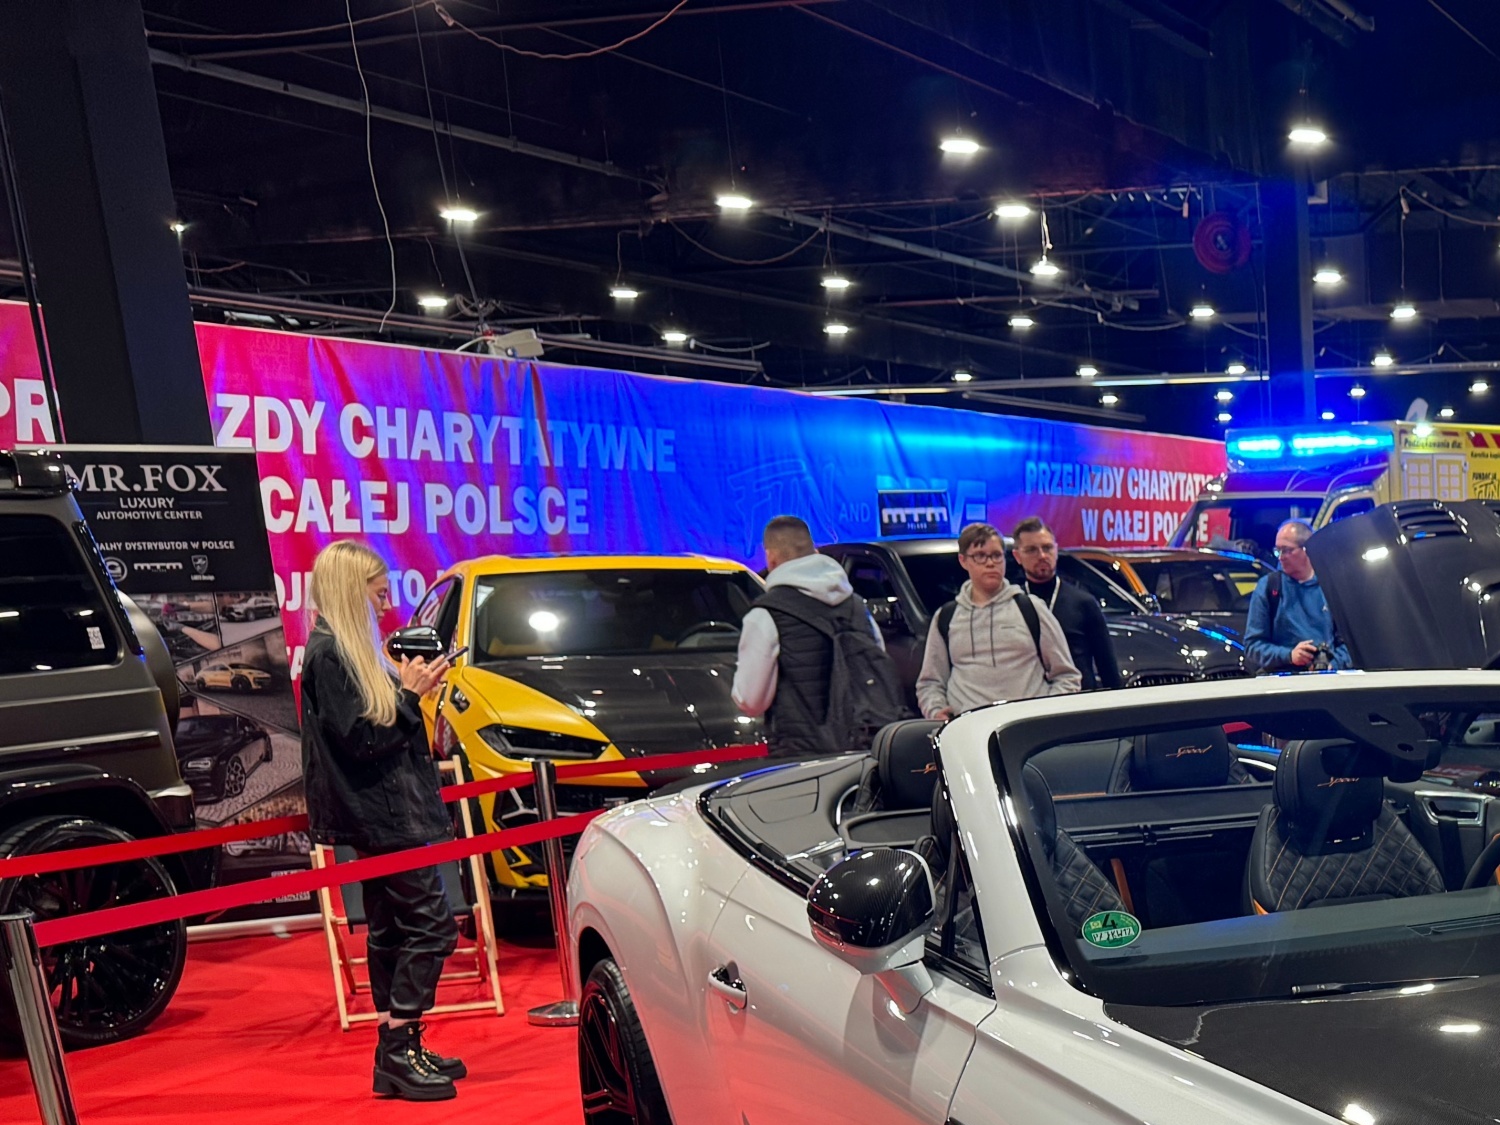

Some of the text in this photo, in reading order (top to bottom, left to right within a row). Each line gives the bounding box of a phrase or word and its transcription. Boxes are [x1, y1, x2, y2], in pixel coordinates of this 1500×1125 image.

[339, 402, 676, 472] CHARYTATYWNE
[64, 463, 228, 493] MR.FOX
[1025, 461, 1125, 499] PRZEJAZDY
[96, 510, 203, 520] AUTOMOTIVE CENTER
[119, 497, 175, 509] LUXURY
[260, 476, 590, 537] CAŁEJ POLSCE
[1081, 508, 1209, 543] W CAŁEJ POLE
[125, 540, 189, 551] DYSTRYBUTOR
[190, 540, 200, 550] W
[202, 540, 236, 550] POLSCE
